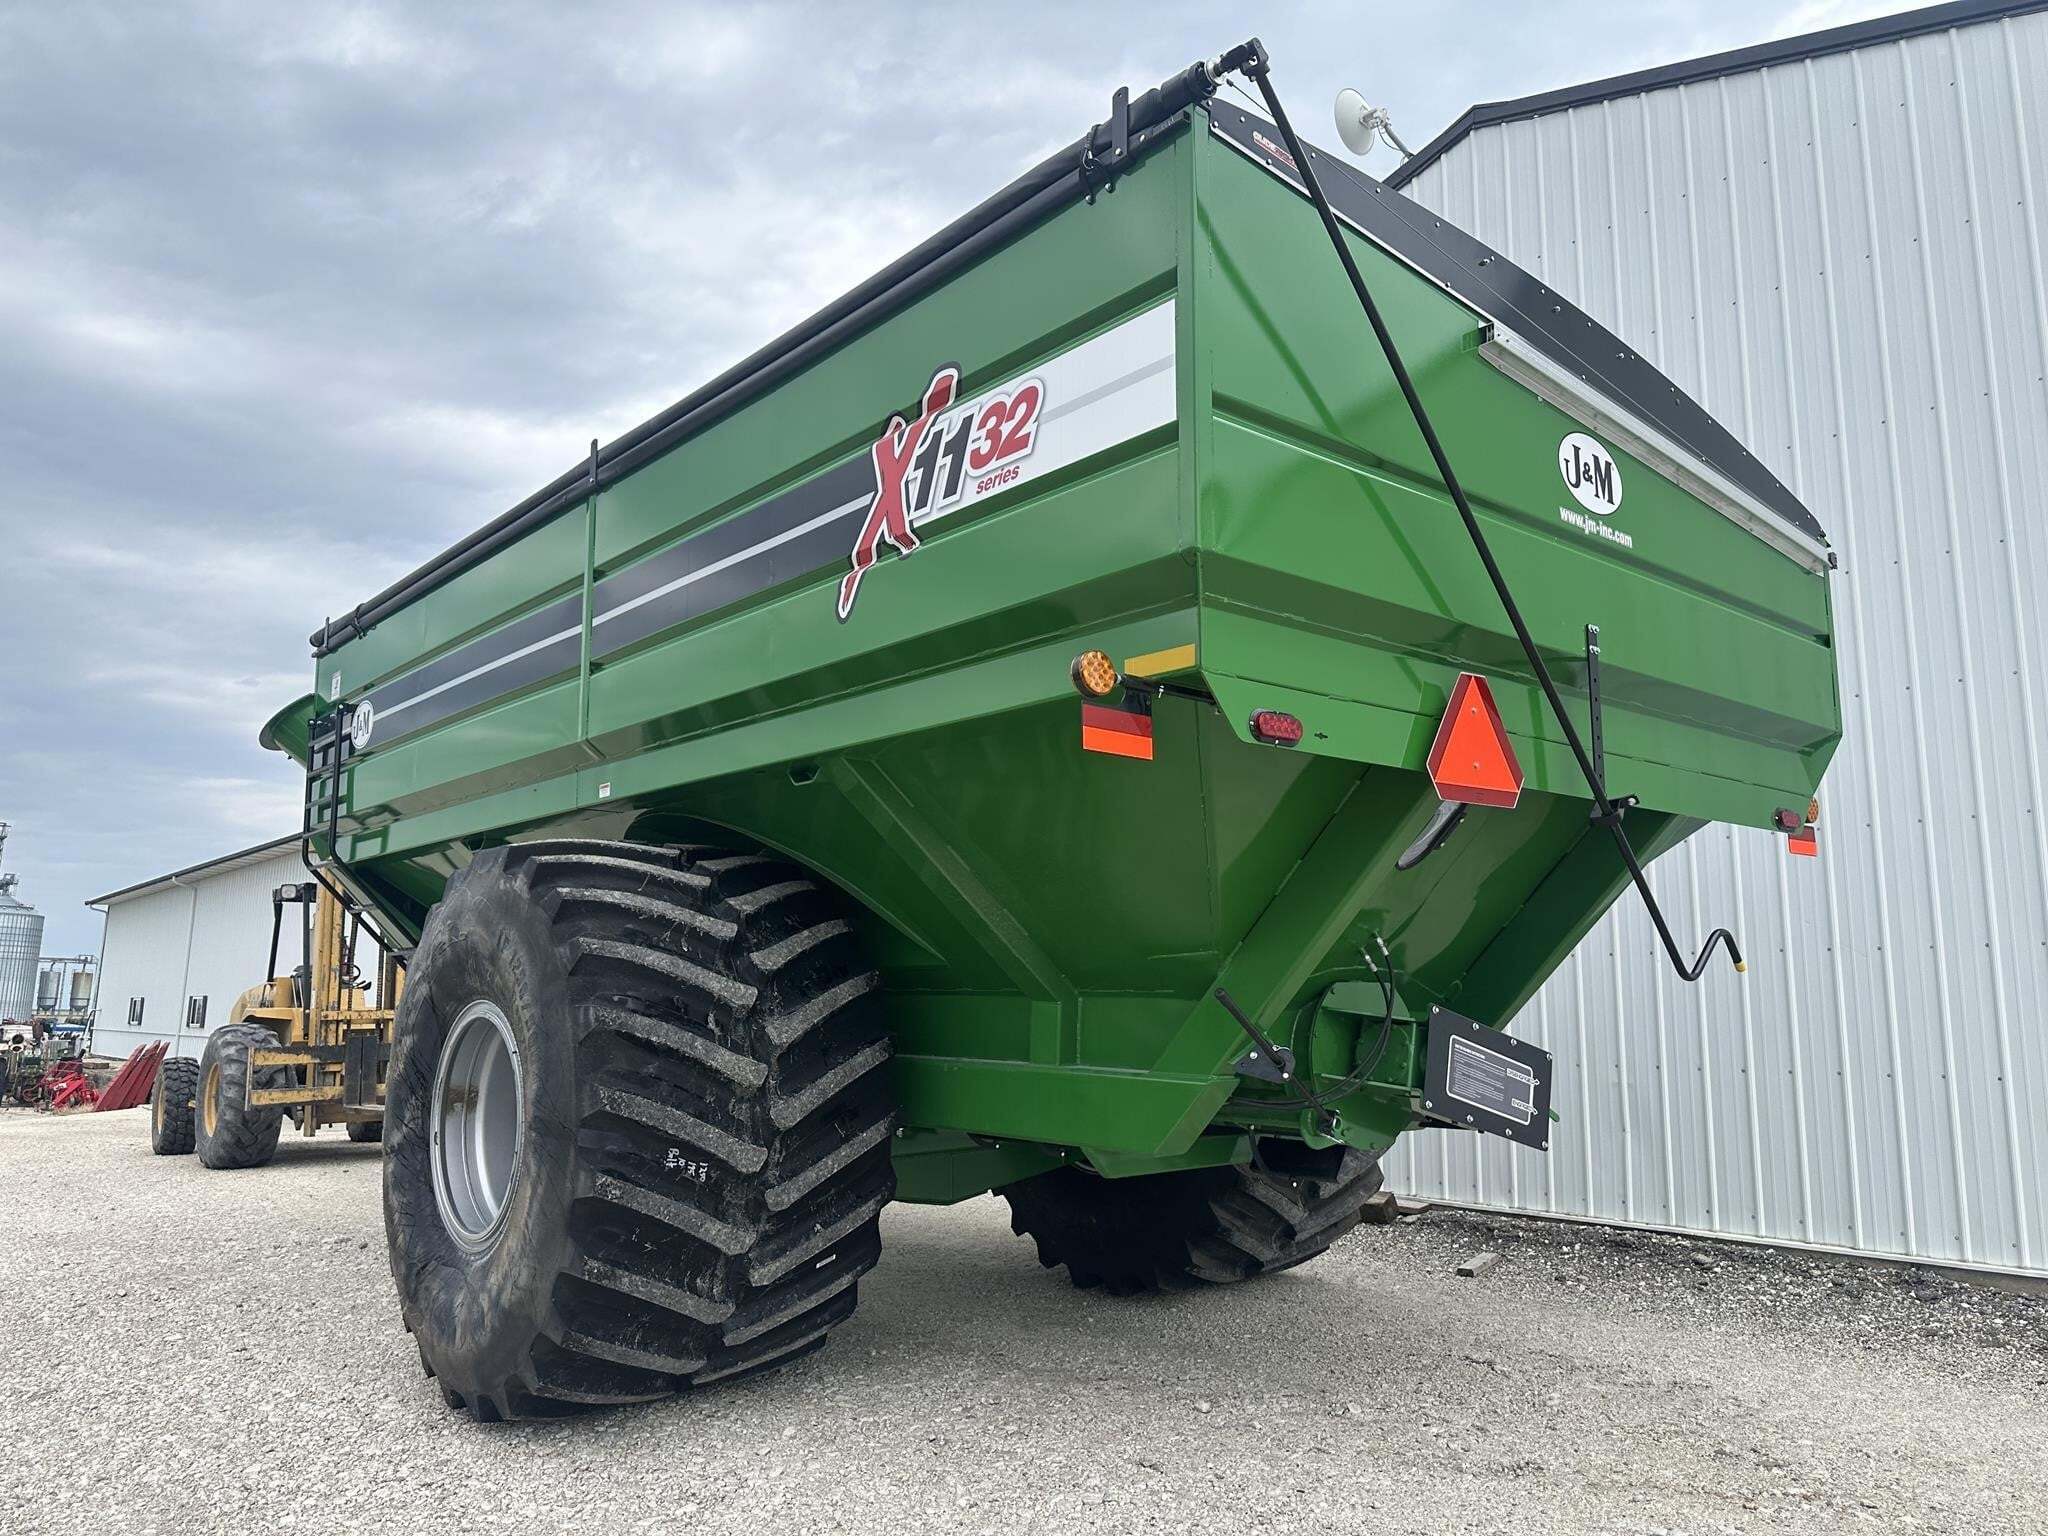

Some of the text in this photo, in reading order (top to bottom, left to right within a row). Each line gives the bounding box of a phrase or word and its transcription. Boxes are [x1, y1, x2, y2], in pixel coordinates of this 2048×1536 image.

[976, 464, 1020, 494] series
[1564, 444, 1615, 505] J&M
[1559, 506, 1633, 548] www.jm-inc.com
